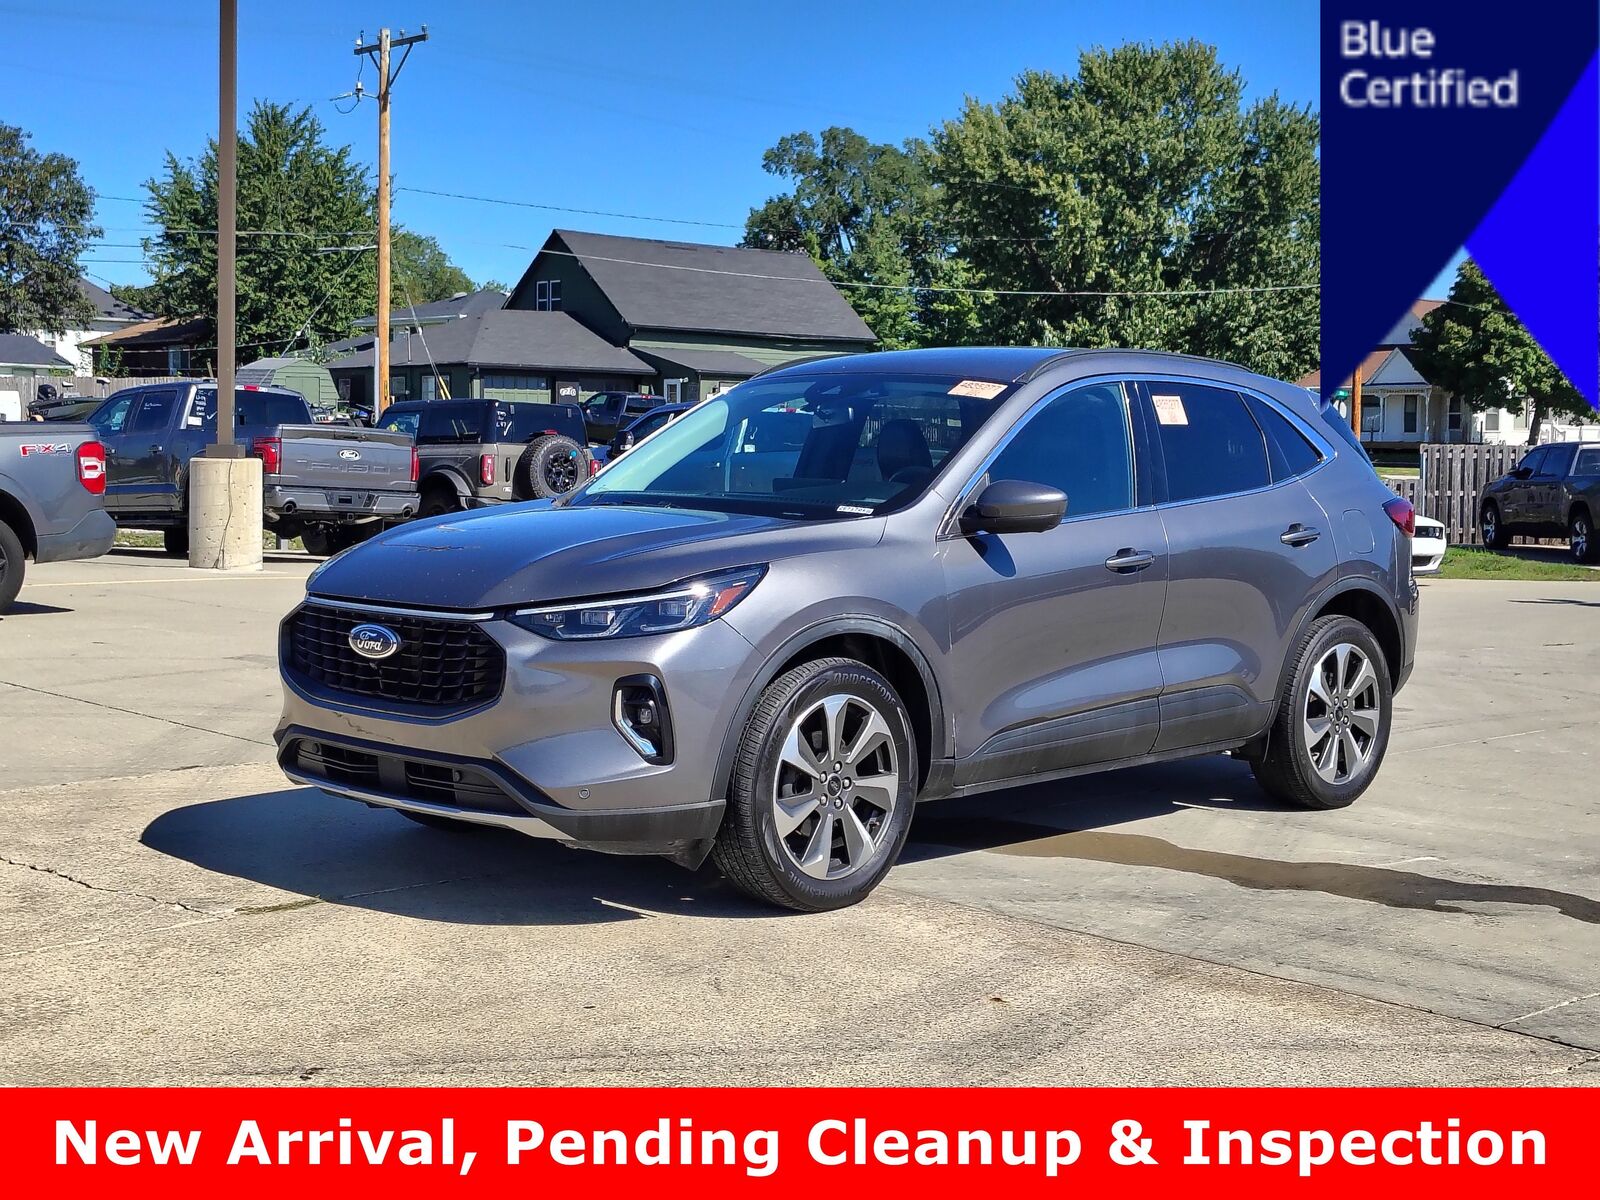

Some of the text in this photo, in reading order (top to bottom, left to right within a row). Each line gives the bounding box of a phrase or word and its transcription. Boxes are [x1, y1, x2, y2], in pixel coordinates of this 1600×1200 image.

[20, 443, 73, 457] FX4
[357, 630, 383, 651] Ford
[833, 672, 897, 705] BRIDGESTONE
